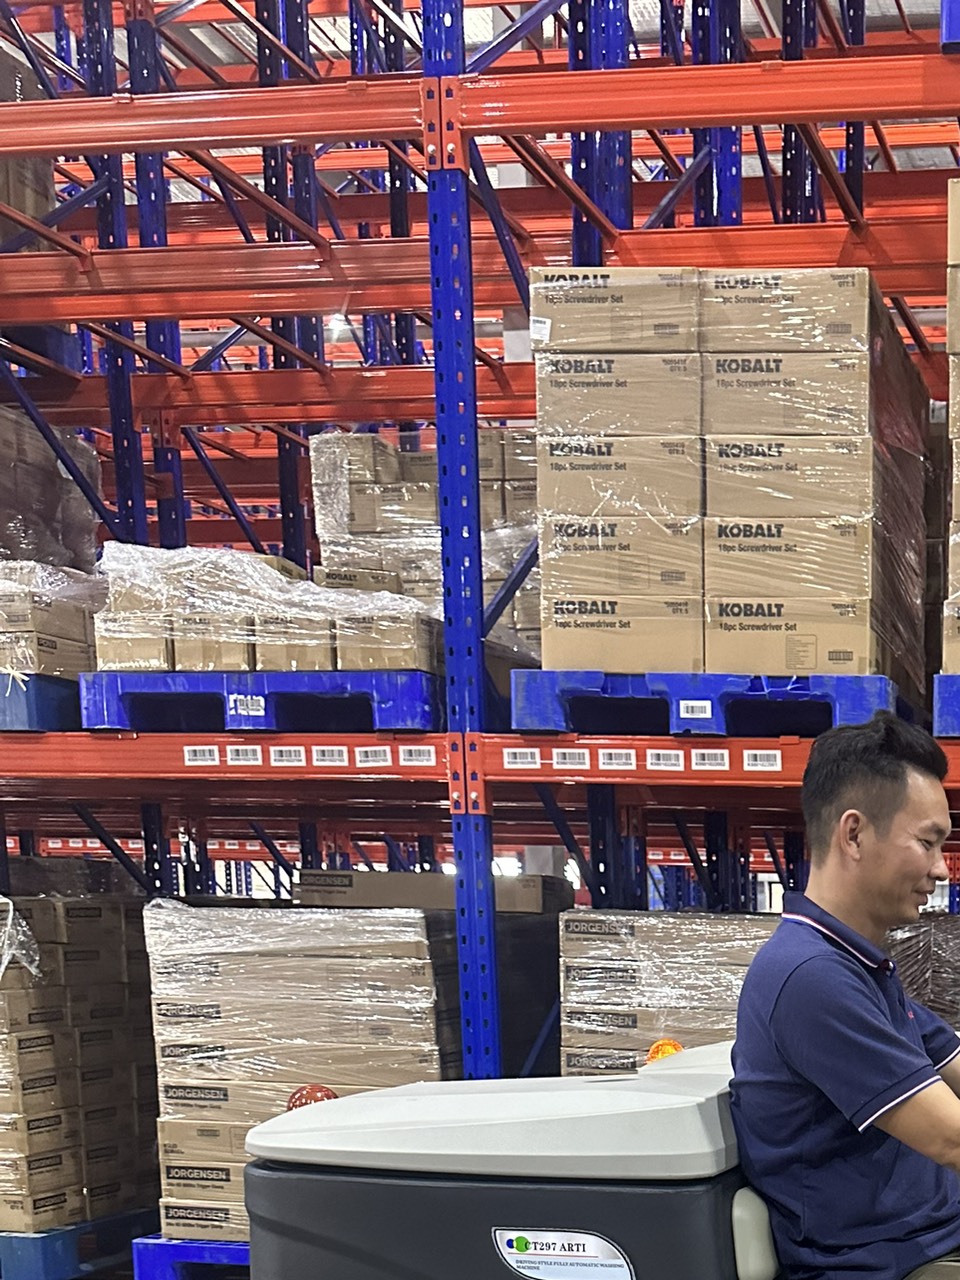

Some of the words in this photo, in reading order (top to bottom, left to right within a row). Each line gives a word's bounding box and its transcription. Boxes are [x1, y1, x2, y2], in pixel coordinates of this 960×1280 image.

[544, 274, 610, 288] KOBALT
[564, 294, 609, 304] Screwdriver
[611, 295, 623, 303] Set
[550, 360, 615, 373] KOBALT
[716, 359, 783, 373] KOBALT
[570, 380, 613, 388] Screwdriver
[615, 380, 628, 388] Set
[735, 380, 781, 388] Screwdriver
[782, 380, 796, 388] Set
[550, 443, 614, 456] KOBALT
[718, 443, 785, 458] KOBALT
[570, 463, 613, 471] Screwdriver
[614, 463, 627, 471] Set
[554, 523, 617, 537] KOBALT
[717, 524, 784, 538] KOBALT
[618, 543, 630, 551] Set
[718, 544, 736, 553] 18pc
[738, 544, 783, 552] Screwdriver
[554, 601, 618, 615] KOBALT
[718, 603, 784, 617] KOBALT
[573, 620, 617, 629] Screwdriver
[618, 621, 631, 629] Set
[720, 623, 737, 631] 18pc
[738, 623, 782, 631] Screwdriver
[783, 623, 797, 631] Set
[166, 1088, 225, 1099] JORGENSEN
[169, 1169, 226, 1179] JORGENSEN
[167, 1209, 225, 1220] JORGENSEN
[559, 1243, 586, 1252] ARTI
